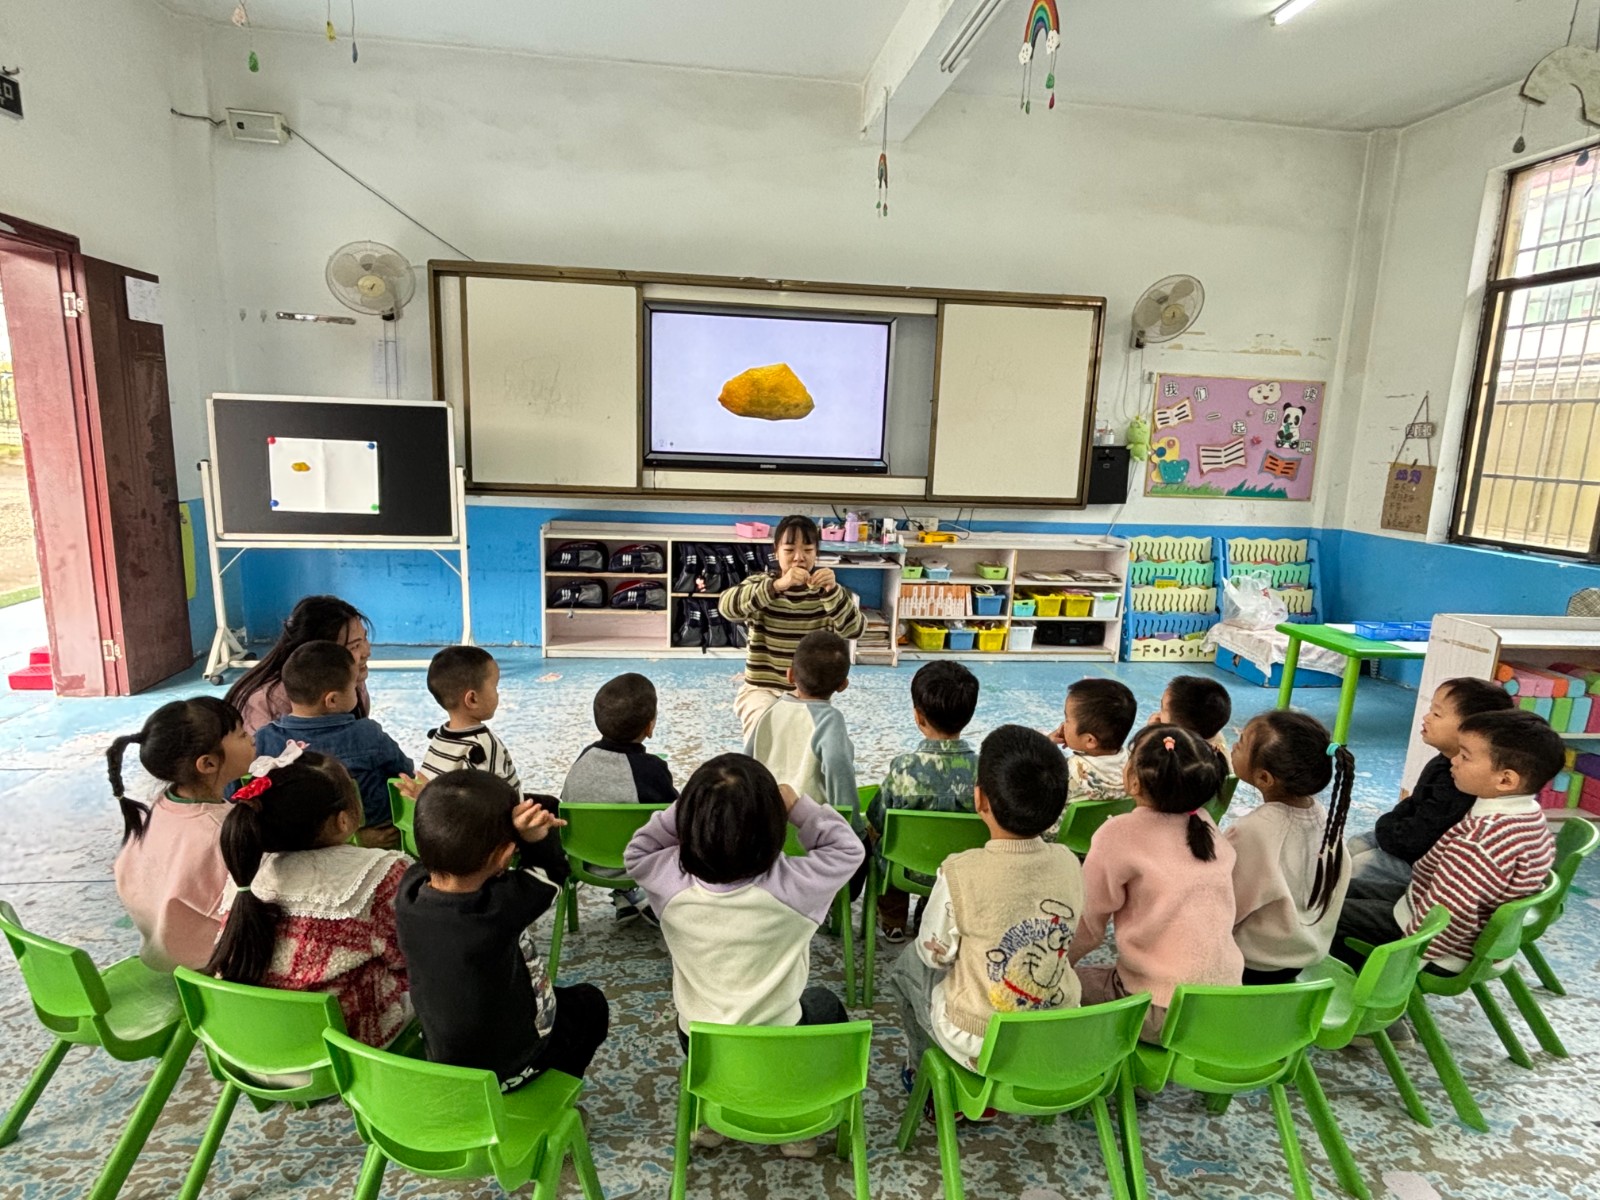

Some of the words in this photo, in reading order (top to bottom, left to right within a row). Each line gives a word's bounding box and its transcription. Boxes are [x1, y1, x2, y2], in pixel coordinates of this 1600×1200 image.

[1165, 382, 1178, 397] 我
[1195, 387, 1208, 401] 们
[1232, 421, 1247, 435] 起
[1264, 409, 1278, 423] 阅
[1304, 386, 1318, 401] 读
